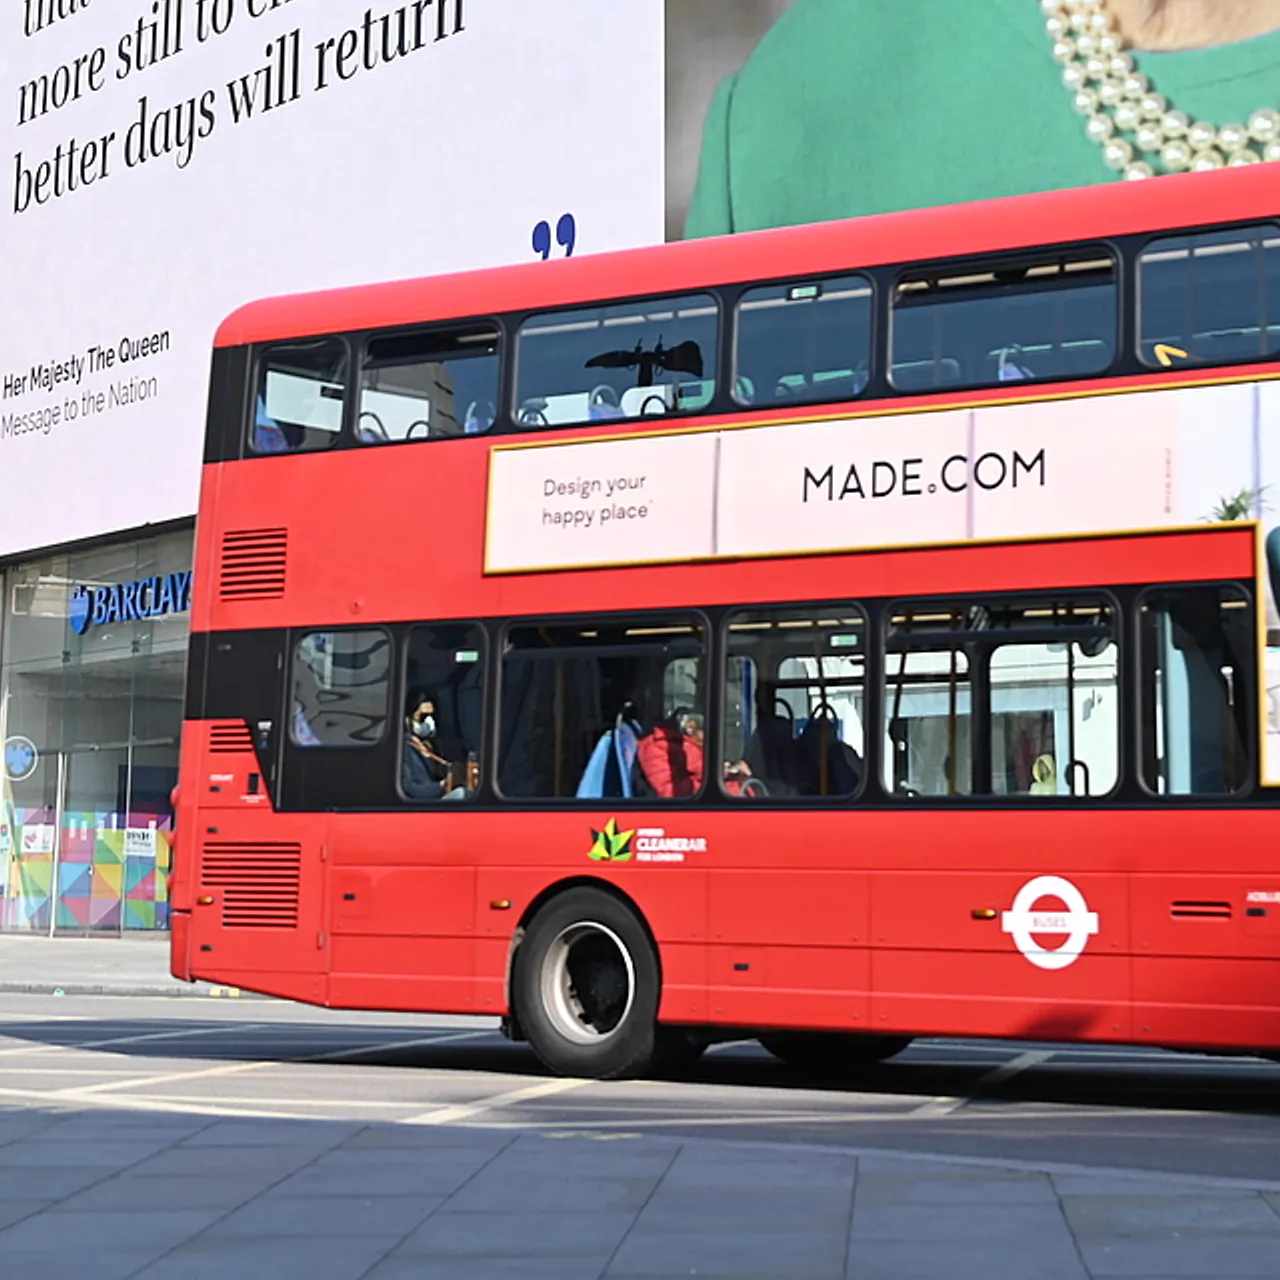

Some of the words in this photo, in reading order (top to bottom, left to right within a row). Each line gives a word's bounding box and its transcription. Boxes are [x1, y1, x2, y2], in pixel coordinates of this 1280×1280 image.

[17, 47, 106, 126] more
[13, 131, 116, 214] better
[124, 89, 216, 169] days
[226, 28, 301, 124] will
[2, 374, 28, 399] Her
[30, 354, 85, 392] Majesty
[87, 345, 115, 373] The
[118, 329, 170, 363] Queen
[1, 404, 61, 440] Message
[63, 397, 78, 421] to
[81, 390, 105, 417] the
[108, 375, 158, 409] Nation
[543, 476, 602, 499] Design
[605, 476, 647, 498] your
[803, 448, 1045, 503] MADE.COM
[542, 508, 596, 529] happy
[93, 571, 194, 625] BARCLAY
[1033, 916, 1066, 928] BUSES
